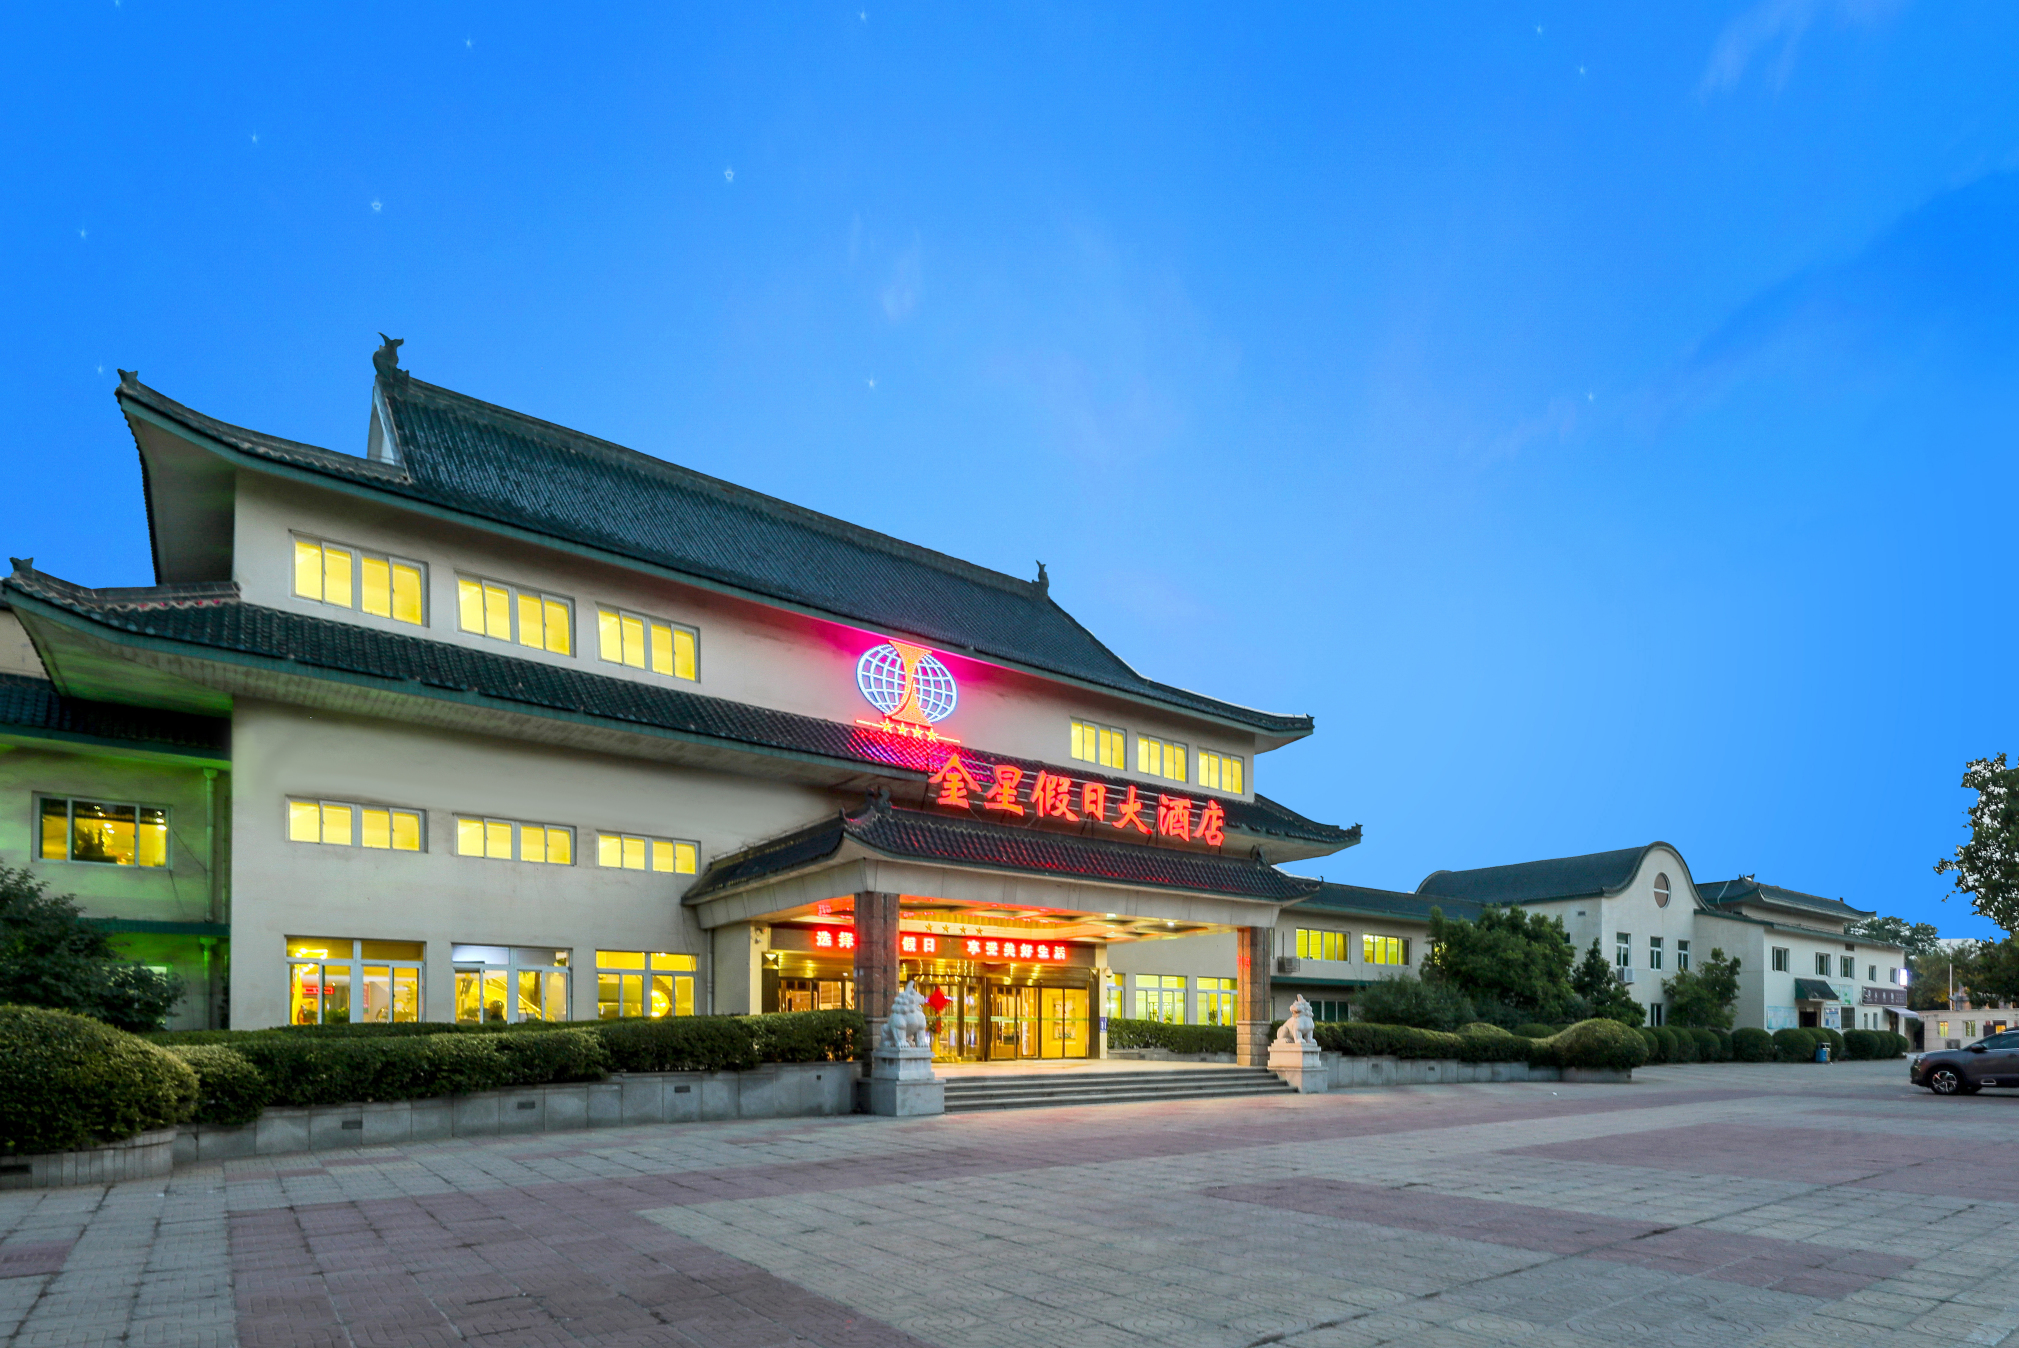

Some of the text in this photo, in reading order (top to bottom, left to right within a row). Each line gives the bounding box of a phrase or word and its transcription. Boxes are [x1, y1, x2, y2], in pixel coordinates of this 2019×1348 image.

[928, 753, 1225, 847] 金星假日大酒店
[816, 930, 1066, 960] 选择 假日 享受美好生活
